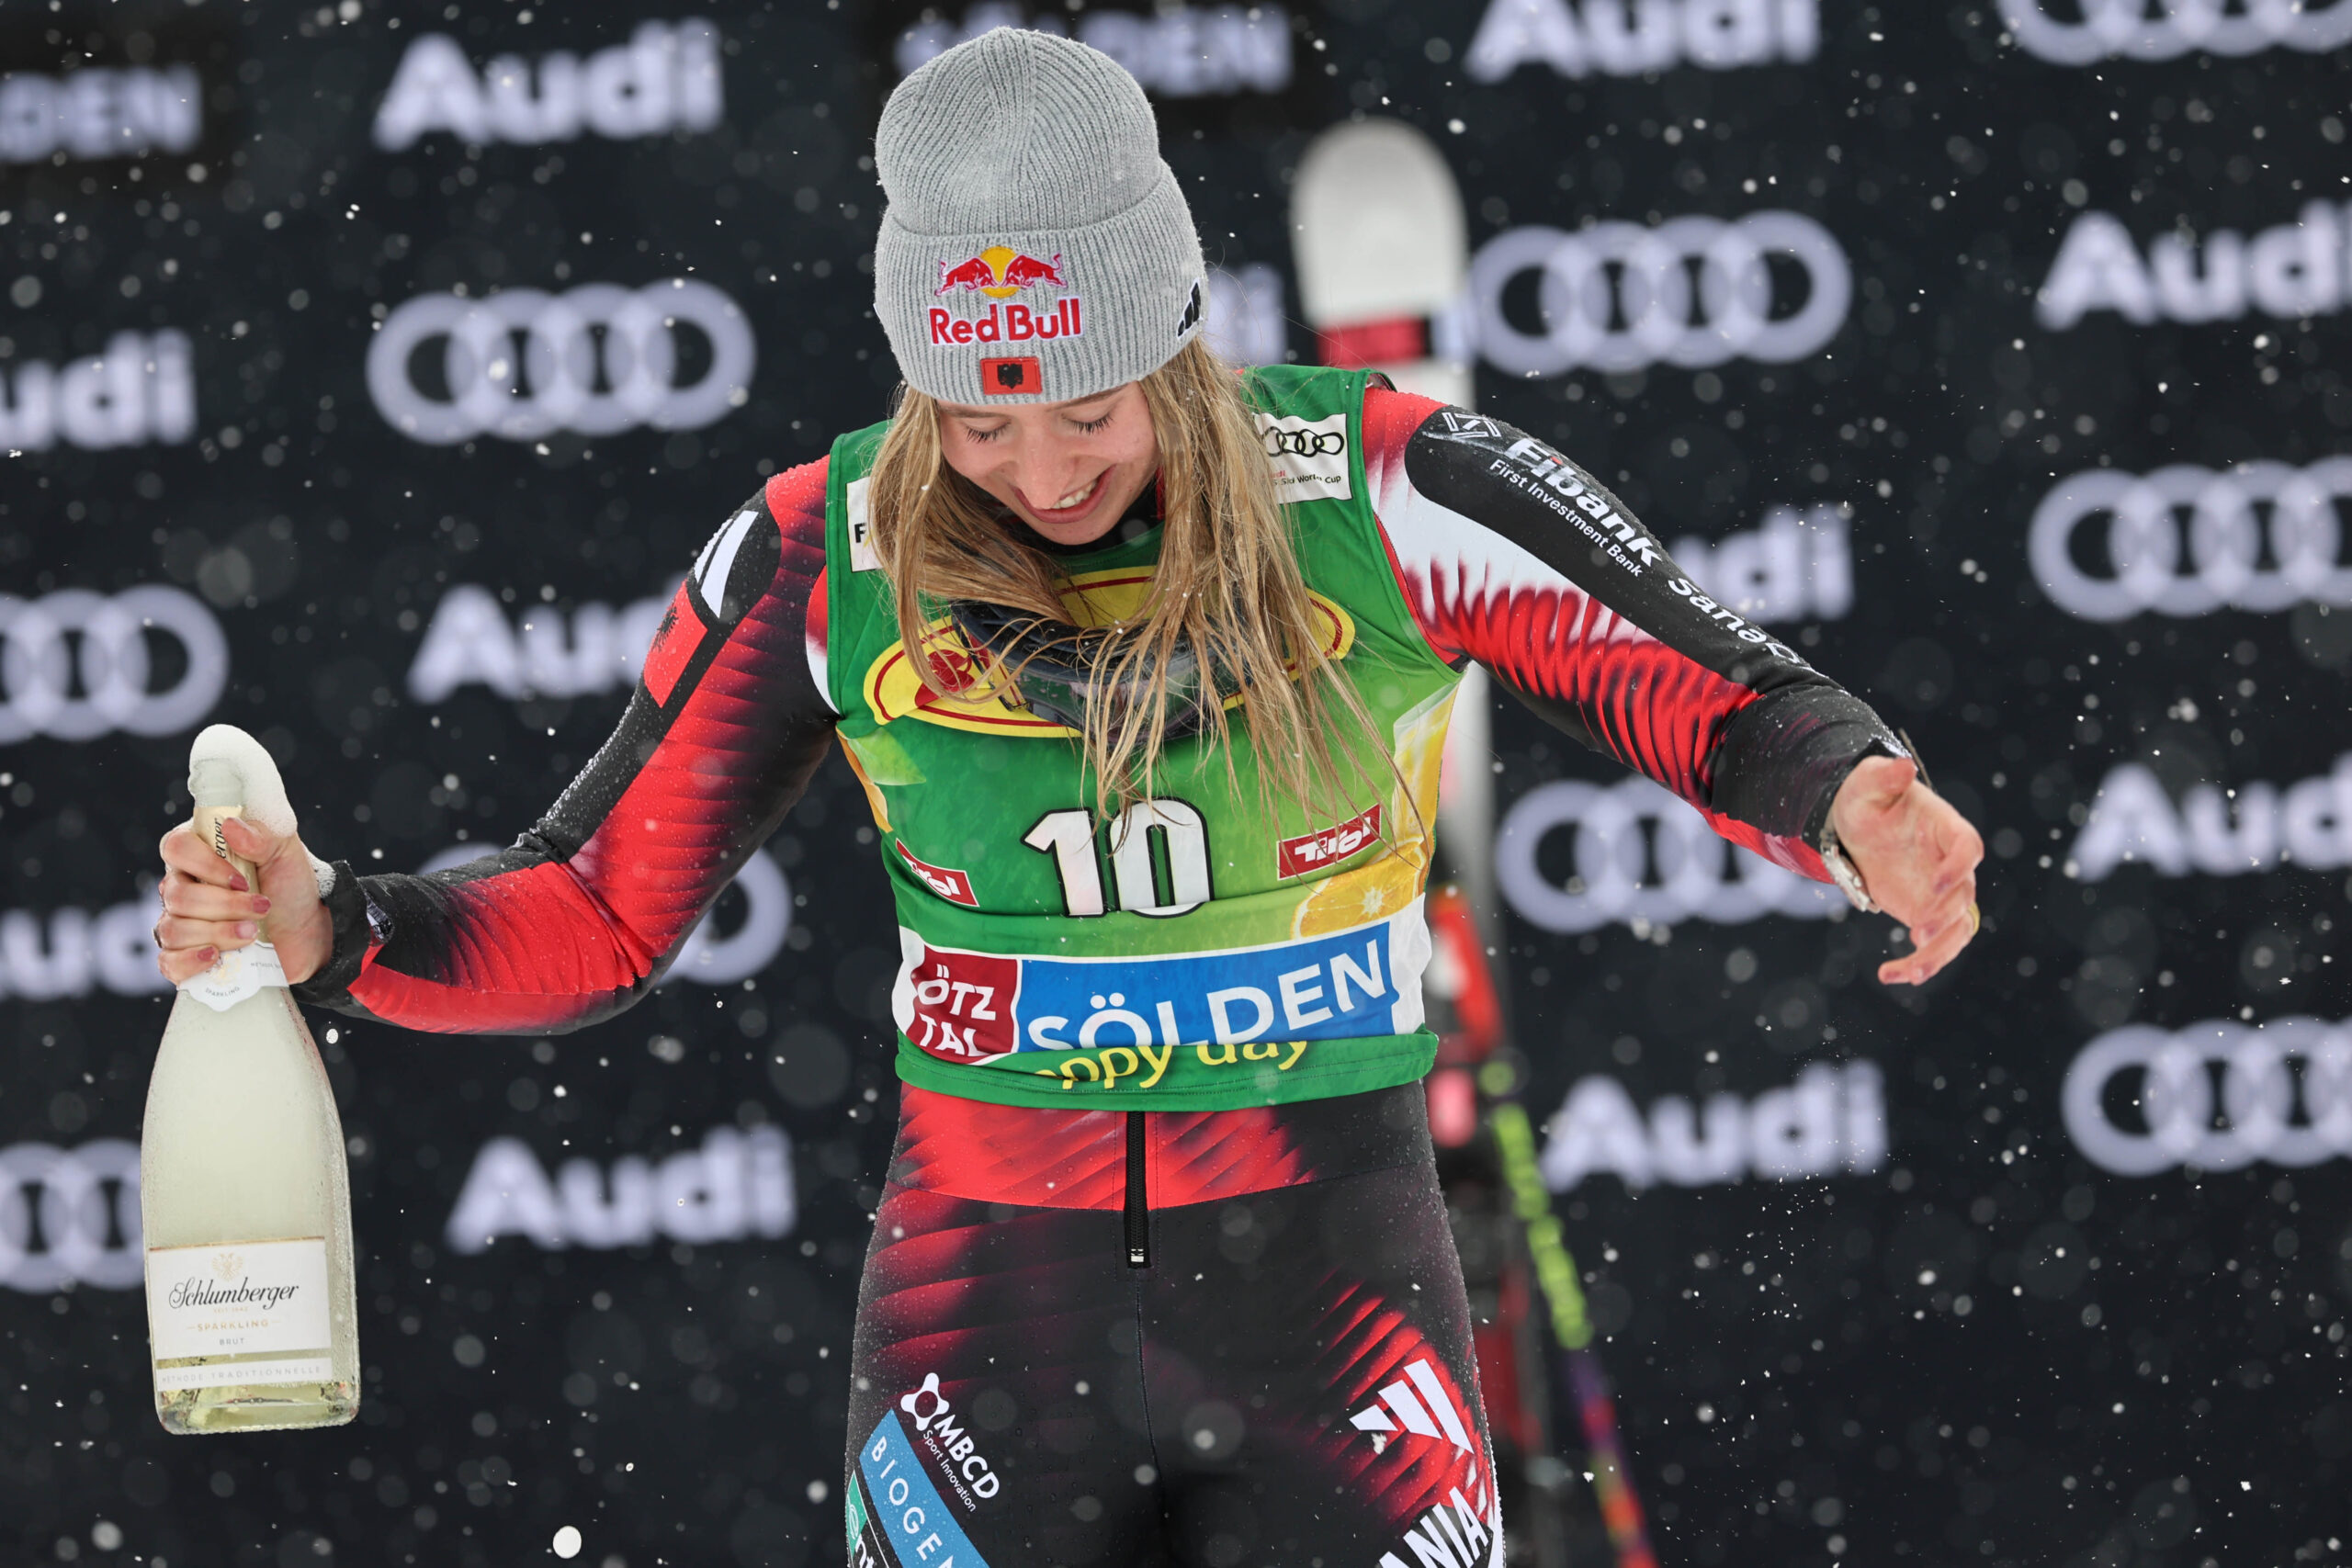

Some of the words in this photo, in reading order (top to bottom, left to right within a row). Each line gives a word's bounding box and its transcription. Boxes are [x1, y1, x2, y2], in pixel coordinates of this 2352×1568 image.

[1464, 0, 1820, 83] Audi
[374, 18, 722, 152] Audi
[2033, 197, 2352, 332] Aud
[929, 303, 1001, 344] Red
[1006, 298, 1082, 341] Bull
[0, 326, 197, 452] udi
[1324, 475, 1341, 484] Cup
[1489, 459, 1530, 489] First
[1527, 482, 1609, 548] Investment
[1607, 543, 1643, 578] Bank
[1504, 437, 1663, 568] Fibank
[1020, 796, 1216, 919] 10
[1295, 816, 1372, 863] Tirol
[2068, 749, 2352, 883] Aud
[917, 963, 997, 1021] ÖTZ
[1027, 938, 1386, 1051] SÖLDEN
[919, 1012, 991, 1057] TAL
[1541, 1060, 1888, 1192] Audi
[444, 1123, 797, 1255] Audi
[169, 1276, 300, 1310] Schlumberger
[197, 1318, 269, 1332] SPARKLING
[210, 1365, 322, 1380] TRADITIONNELLE
[219, 1337, 245, 1346] BRUT
[922, 1429, 944, 1461] Sport
[940, 1458, 977, 1513] Innovation
[933, 1414, 1000, 1499] MBCD
